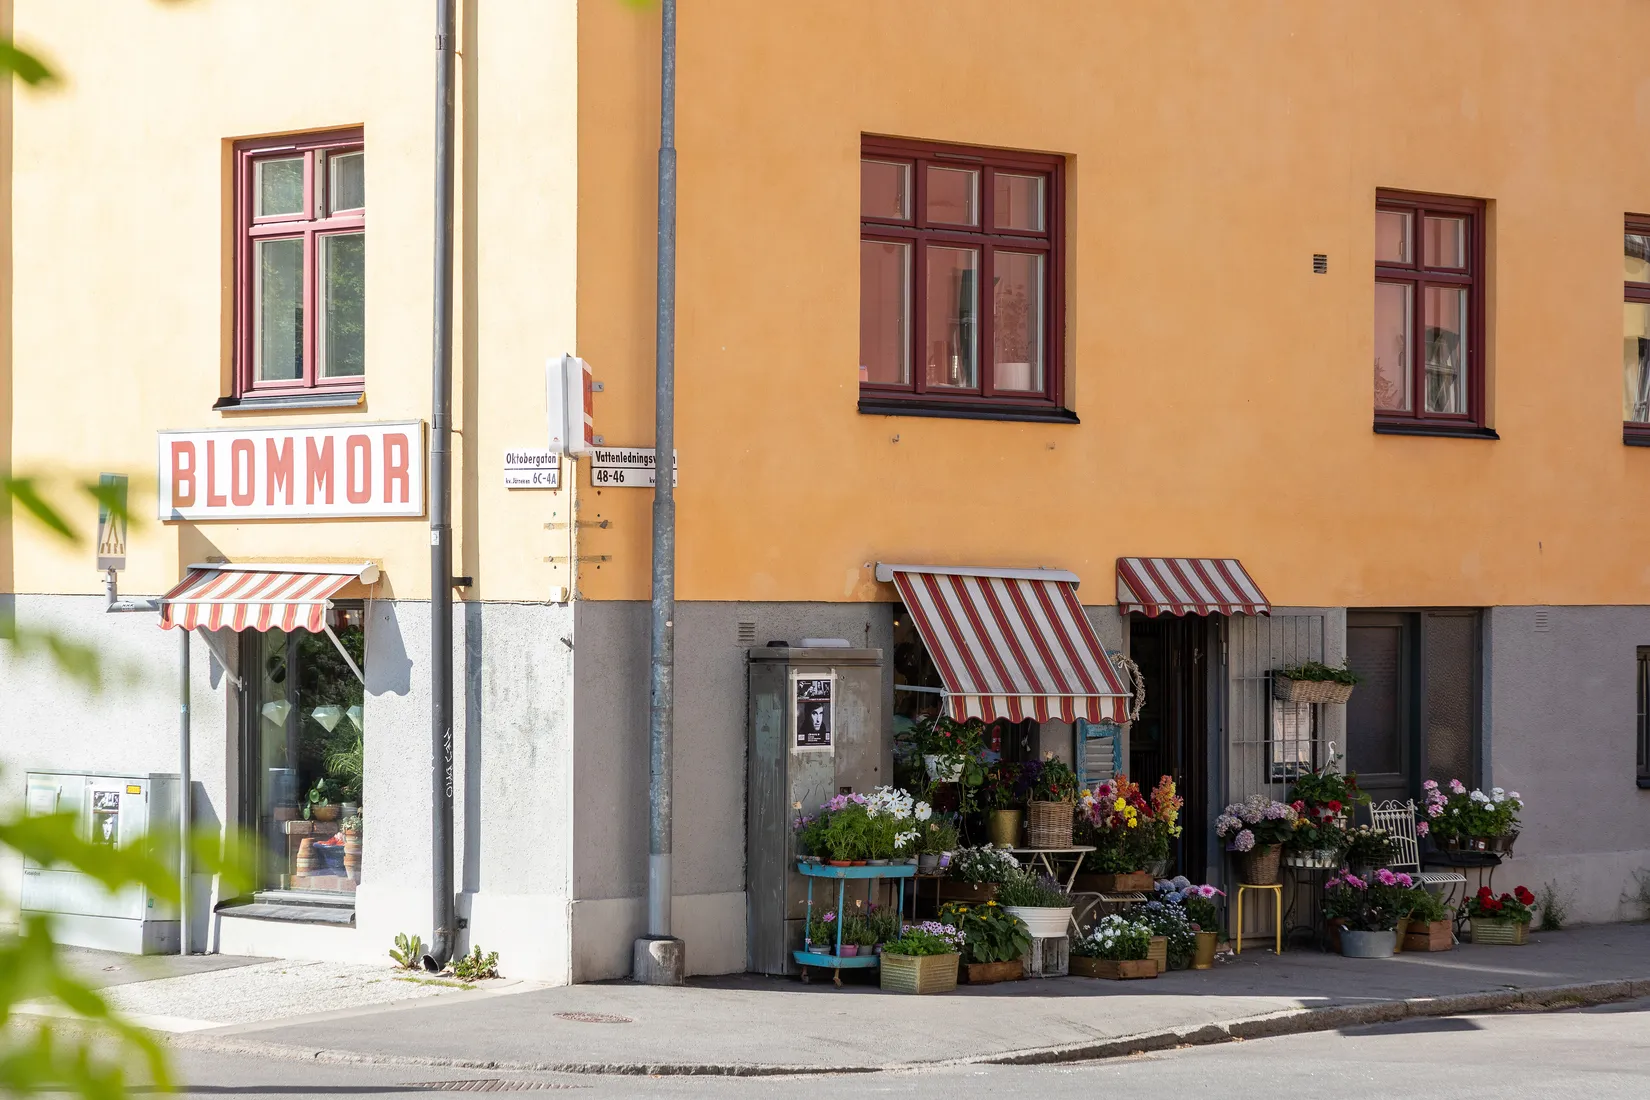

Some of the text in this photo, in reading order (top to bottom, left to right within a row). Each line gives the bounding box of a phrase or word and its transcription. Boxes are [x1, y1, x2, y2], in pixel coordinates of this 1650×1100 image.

[506, 452, 556, 467] Oktobergatan
[595, 451, 676, 466] Vattenledningsvn
[171, 433, 409, 507] BLOMMOR
[597, 470, 625, 483] 48-46
[532, 472, 556, 484] 6C-4A
